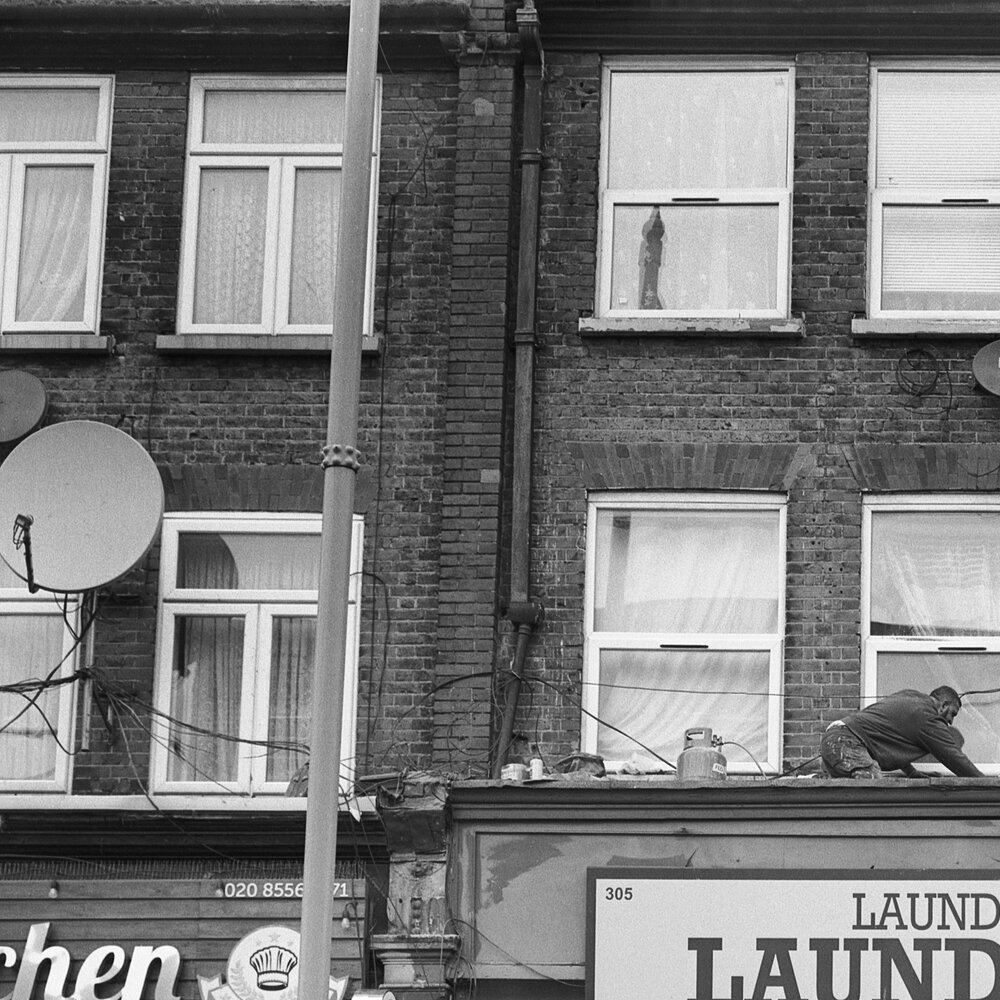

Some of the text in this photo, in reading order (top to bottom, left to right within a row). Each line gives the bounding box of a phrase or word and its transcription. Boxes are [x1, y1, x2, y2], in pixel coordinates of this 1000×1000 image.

[224, 882, 349, 898] 020 8556 71
[604, 886, 634, 901] 305
